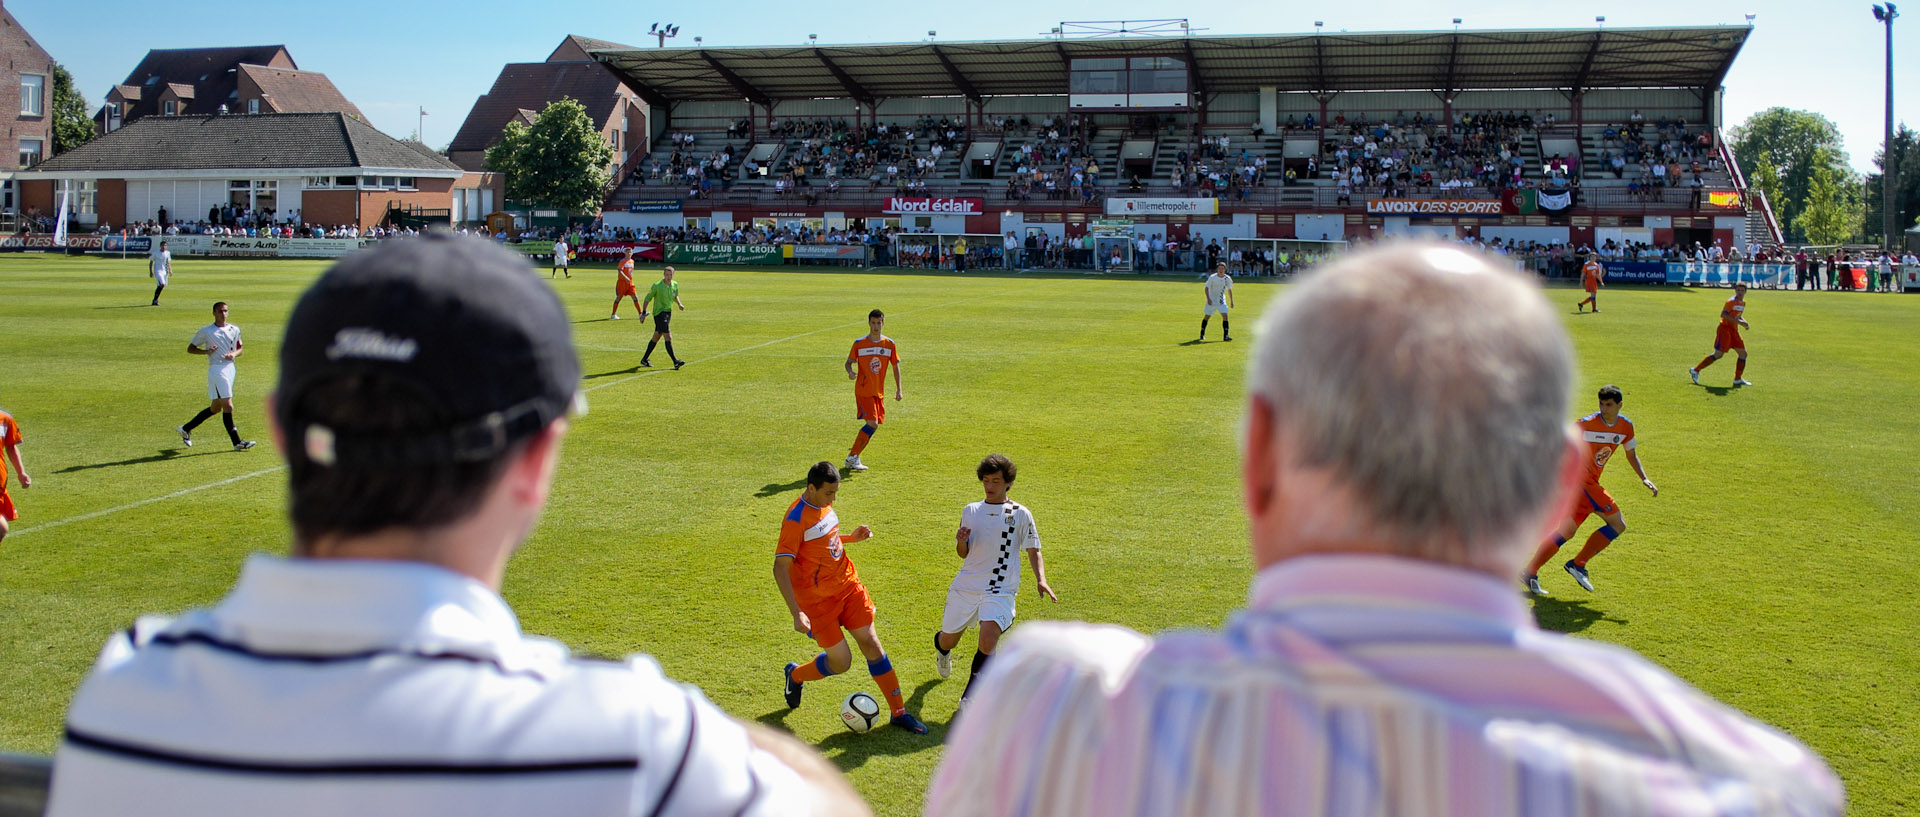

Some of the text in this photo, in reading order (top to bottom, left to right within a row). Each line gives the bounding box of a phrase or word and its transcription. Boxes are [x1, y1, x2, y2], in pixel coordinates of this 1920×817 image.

[890, 198, 974, 212] Nord éclair
[1137, 201, 1197, 212] lillemetropole.fr
[1420, 202, 1447, 212] DES
[1448, 202, 1502, 213] SPORTS
[26, 237, 51, 247] DES
[52, 237, 102, 247] ORTS
[254, 240, 278, 248] Auto
[589, 245, 626, 255] Métropol
[1668, 265, 1685, 273] LA
[1686, 265, 1716, 274] OIX
